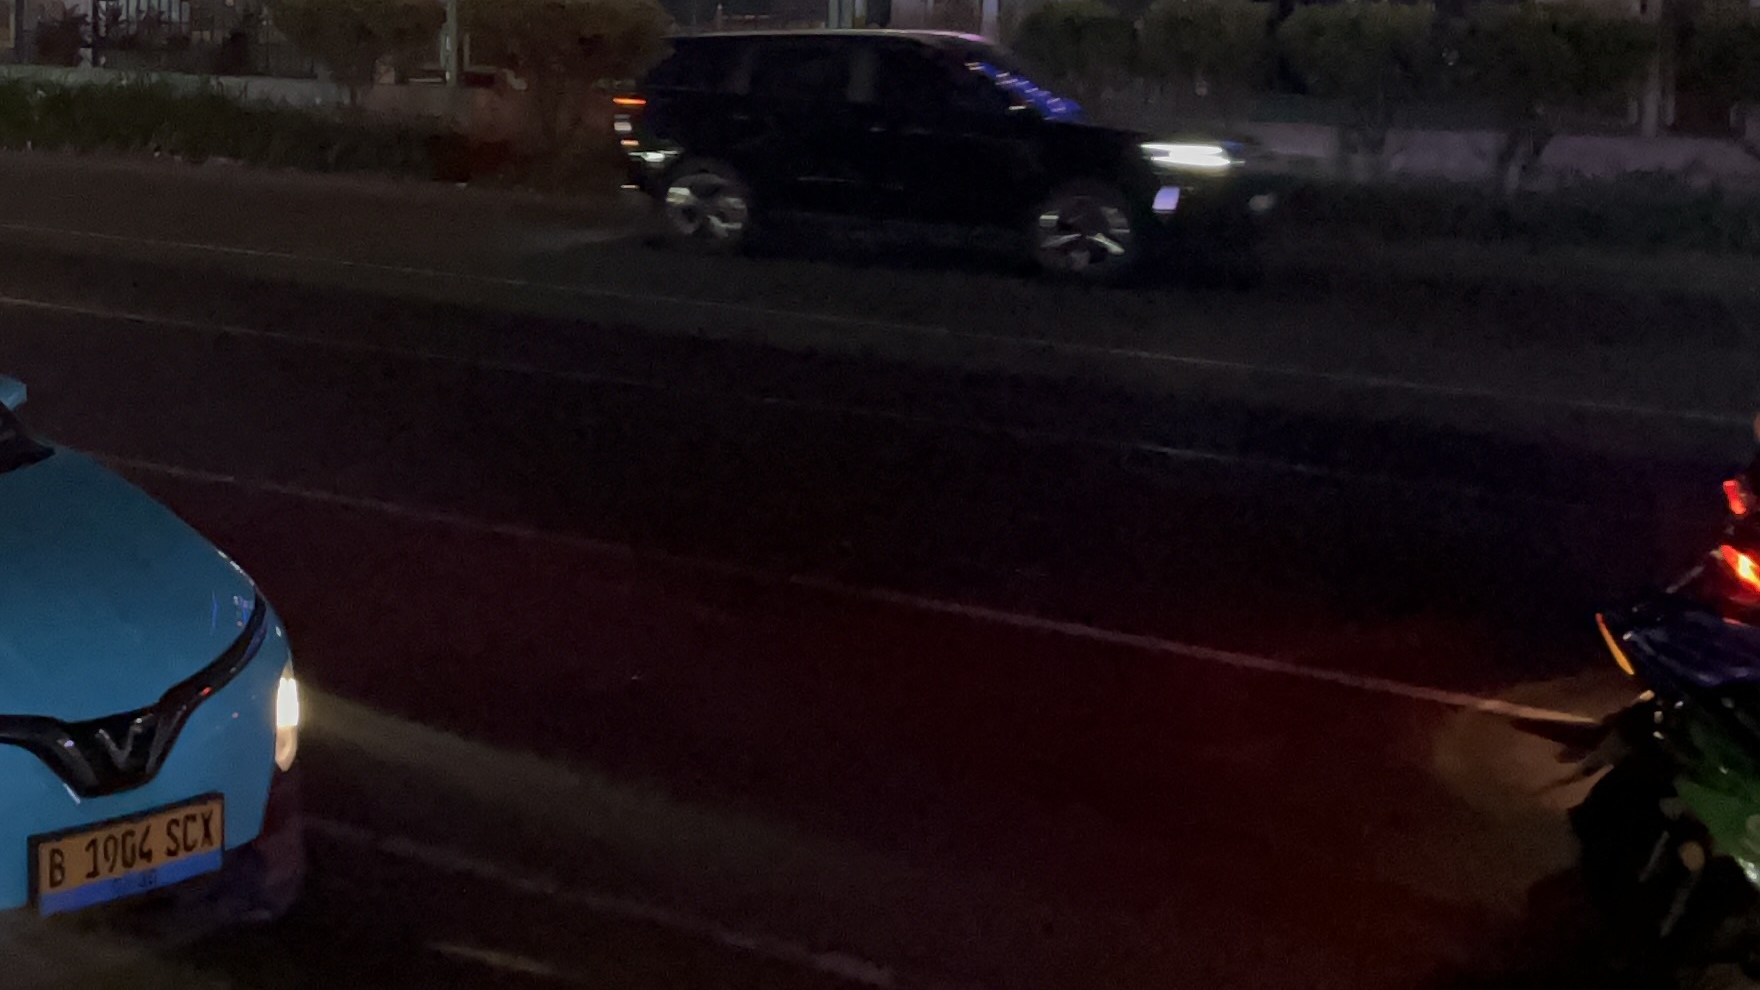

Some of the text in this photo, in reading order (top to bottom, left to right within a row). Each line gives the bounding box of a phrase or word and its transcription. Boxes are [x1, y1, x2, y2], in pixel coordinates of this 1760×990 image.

[49, 847, 66, 888] B
[84, 824, 154, 878] 1904
[165, 809, 215, 857] SCX
